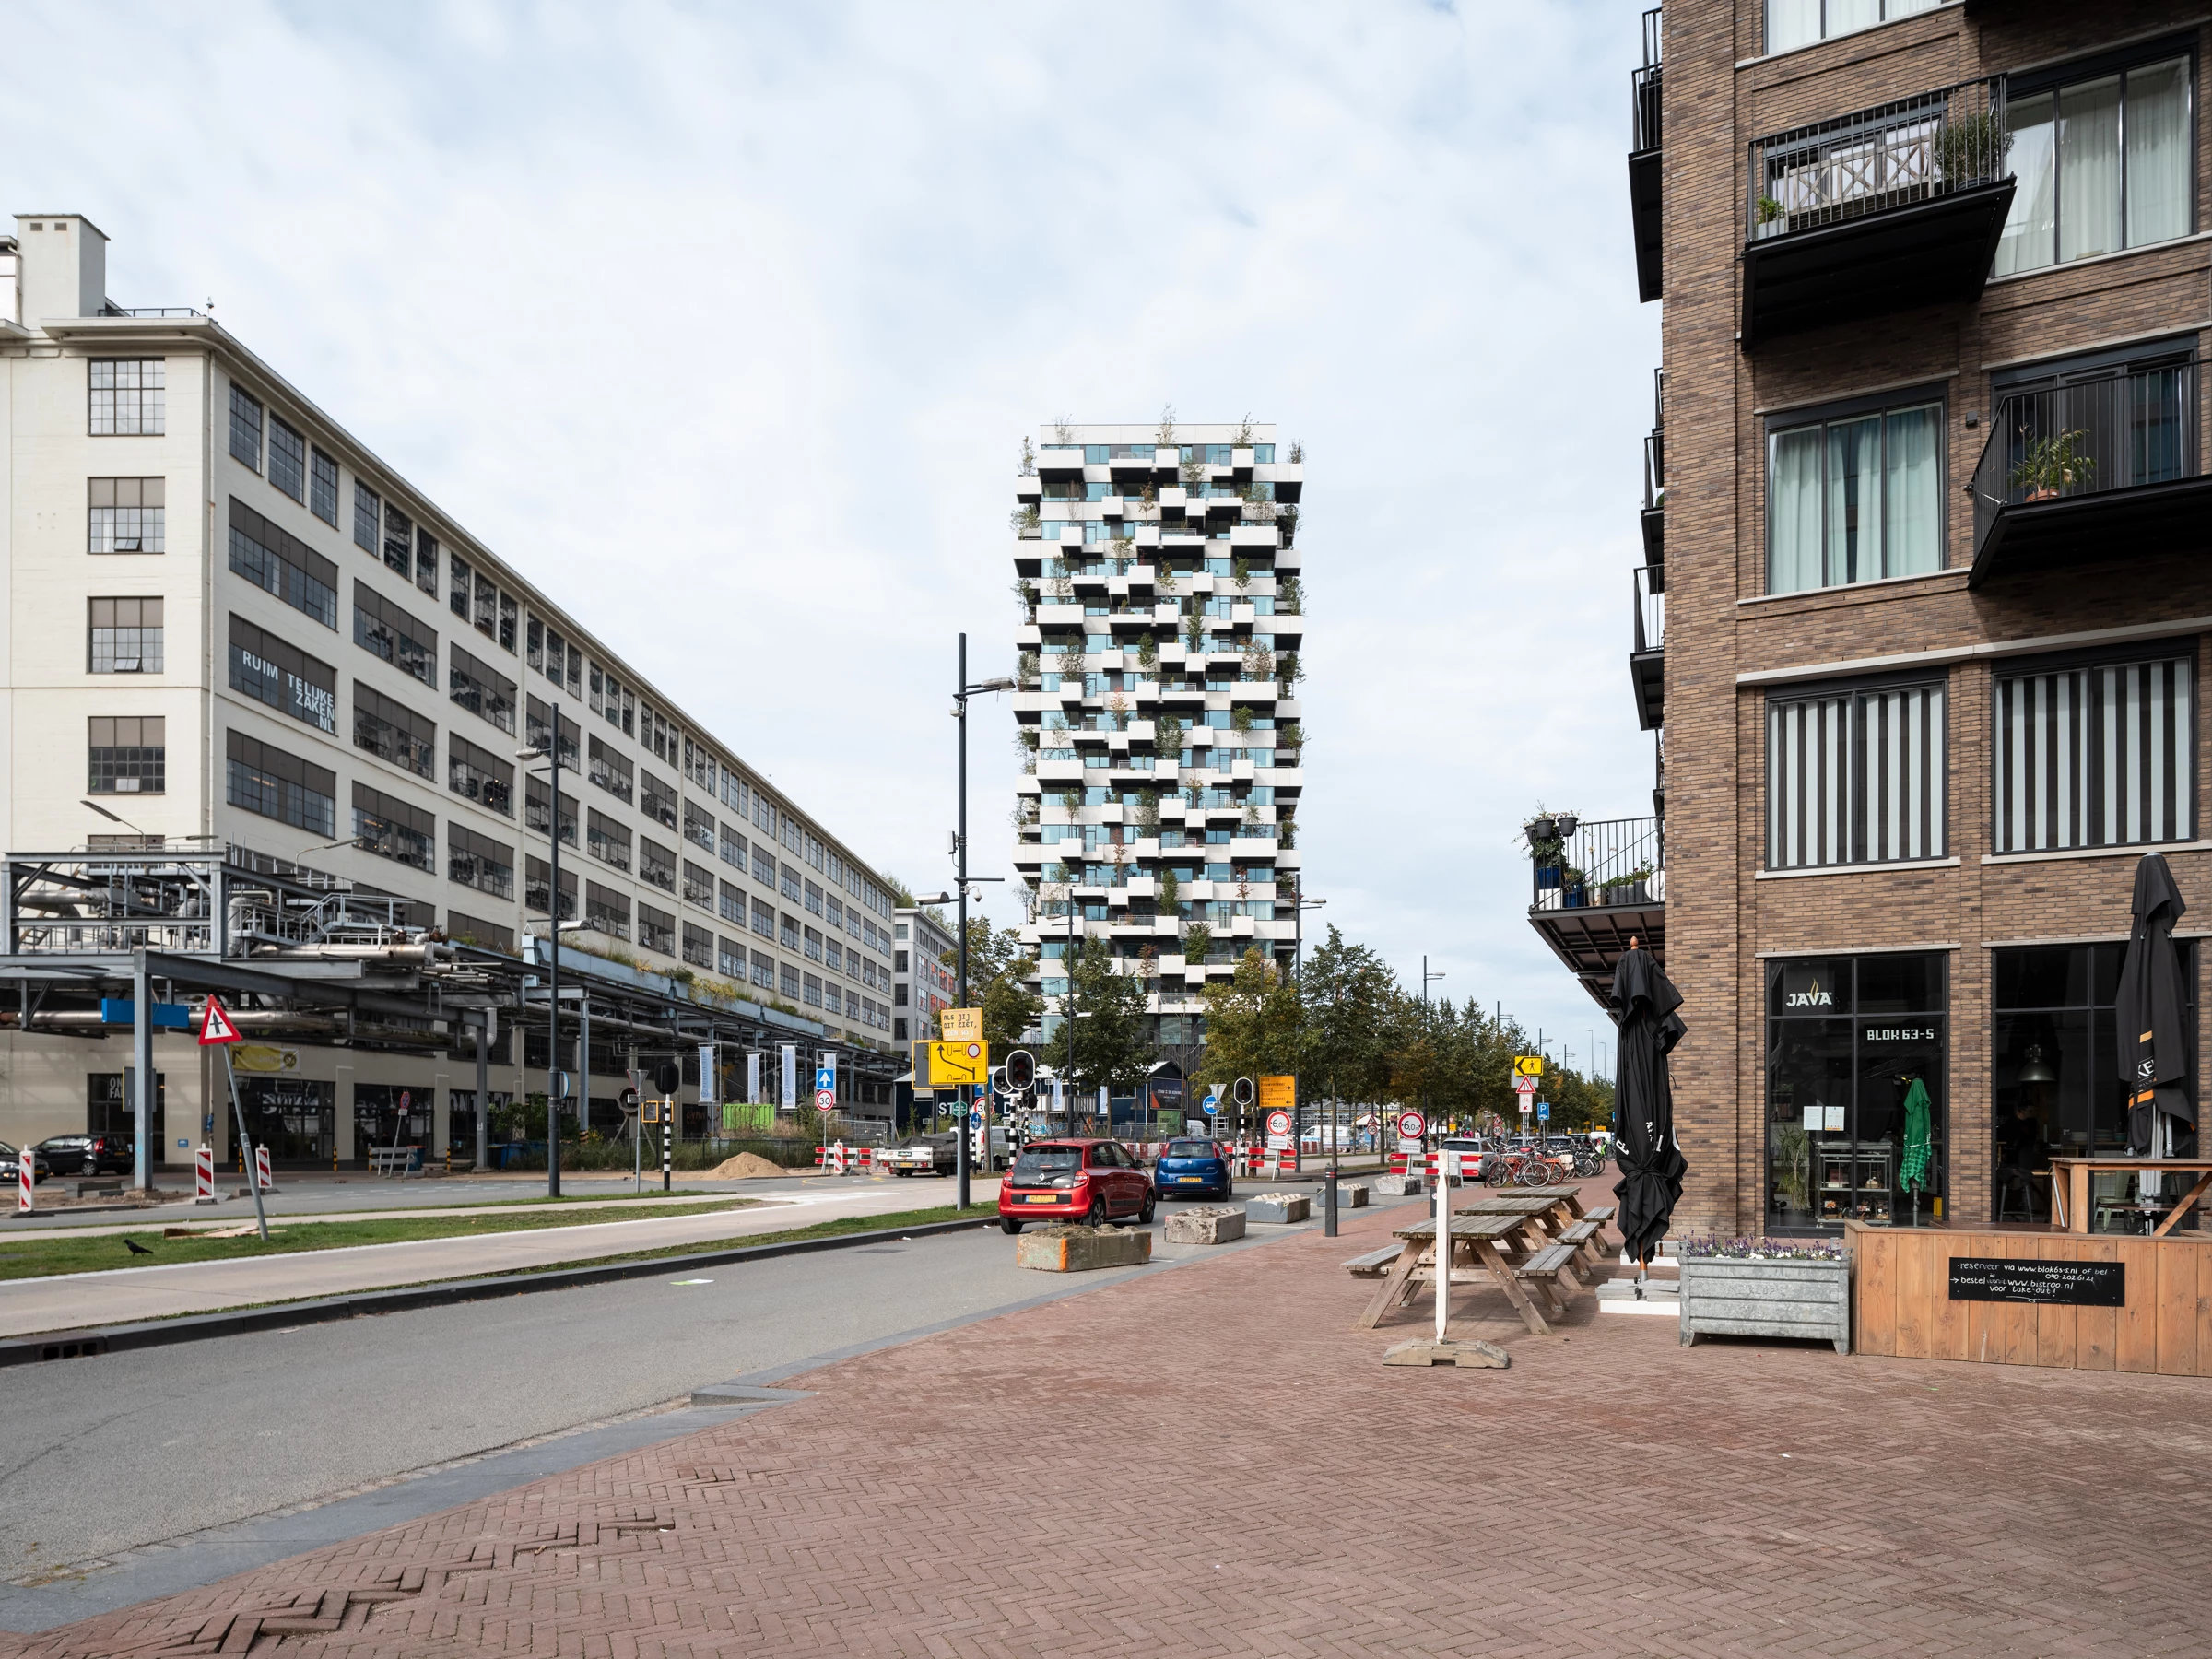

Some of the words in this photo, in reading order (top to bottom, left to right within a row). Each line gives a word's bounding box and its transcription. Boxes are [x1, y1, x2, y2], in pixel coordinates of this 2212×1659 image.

[242, 650, 278, 681] RUIM
[295, 690, 335, 722] ZAKEN
[1785, 992, 1833, 1007] JAVA
[958, 1013, 970, 1021] JIJ
[1866, 1029, 1900, 1041] BLOK
[818, 1097, 831, 1105] 30
[1959, 1262, 1999, 1271] reserveer
[2003, 1264, 2016, 1272] via
[1960, 1276, 1986, 1285] bestel
